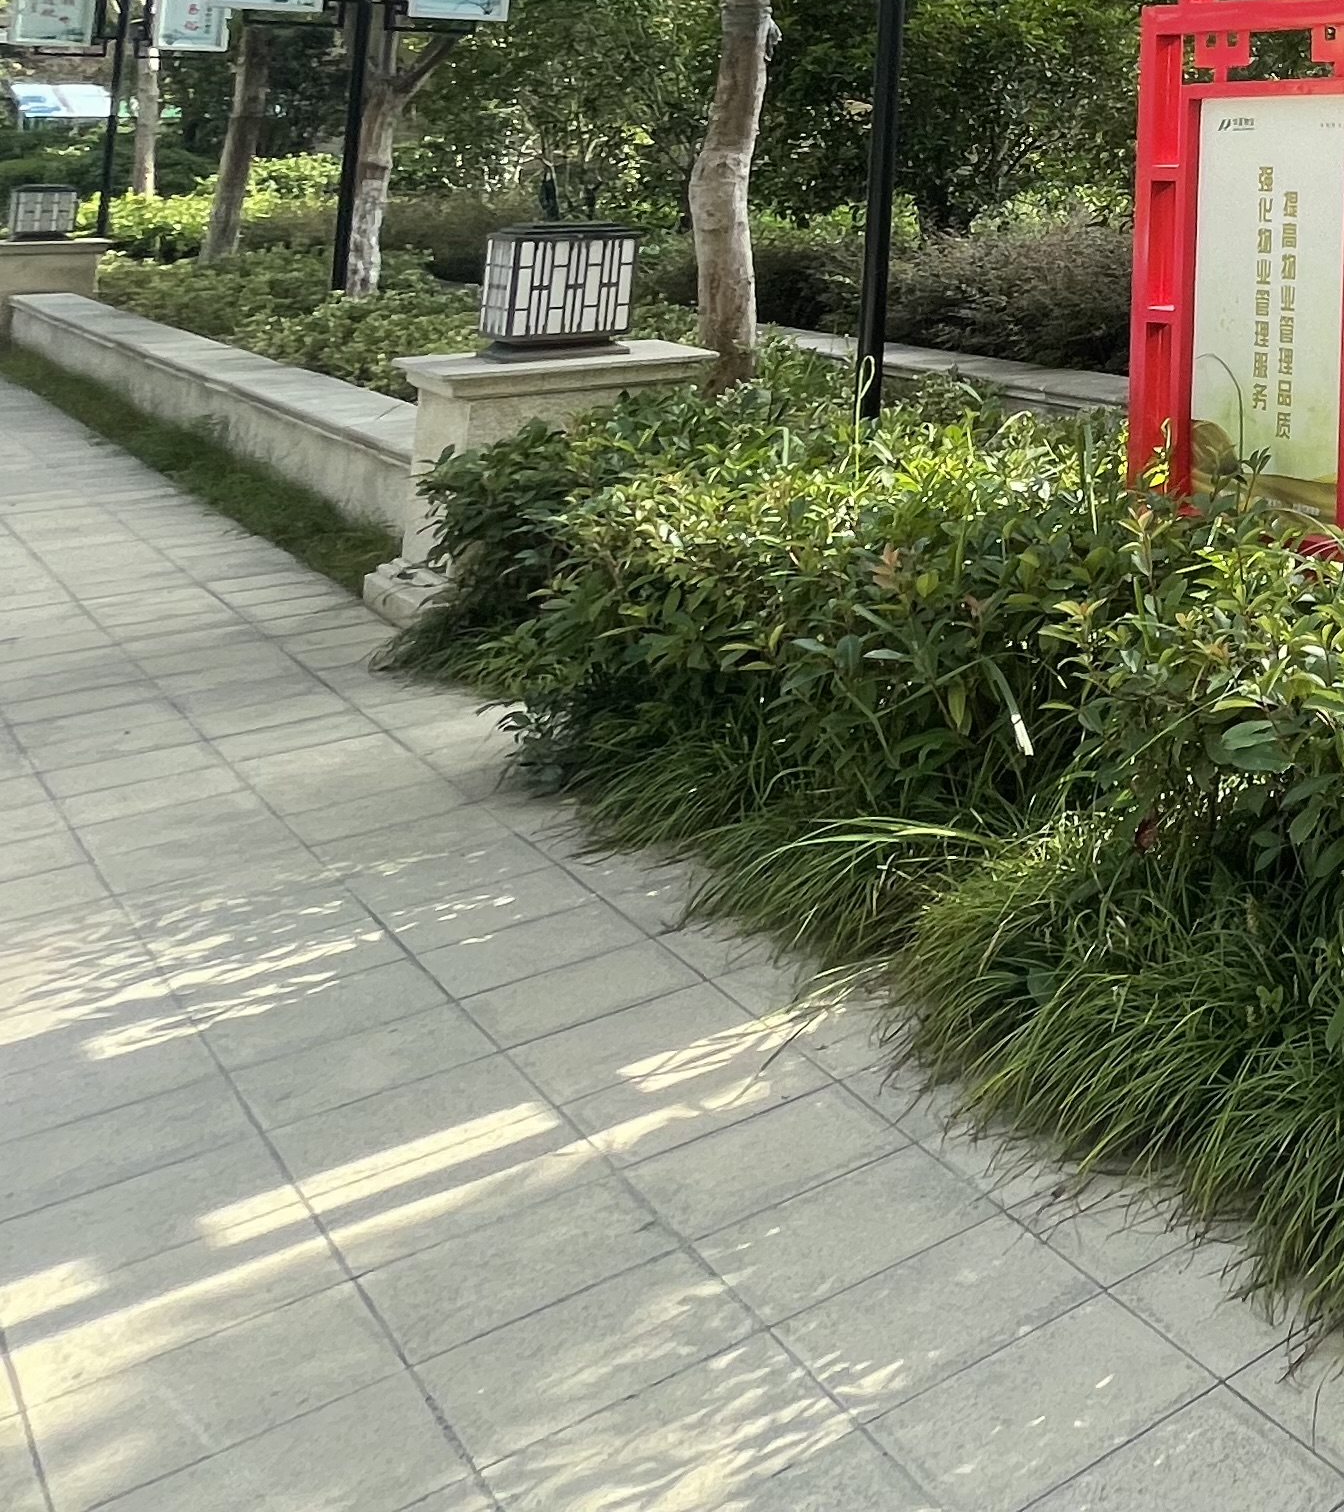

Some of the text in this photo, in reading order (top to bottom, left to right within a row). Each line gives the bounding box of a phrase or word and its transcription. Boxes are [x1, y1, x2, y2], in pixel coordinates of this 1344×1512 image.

[1252, 166, 1274, 412] 强化物业管理服务
[1275, 190, 1299, 440] 提高物业管理品质
